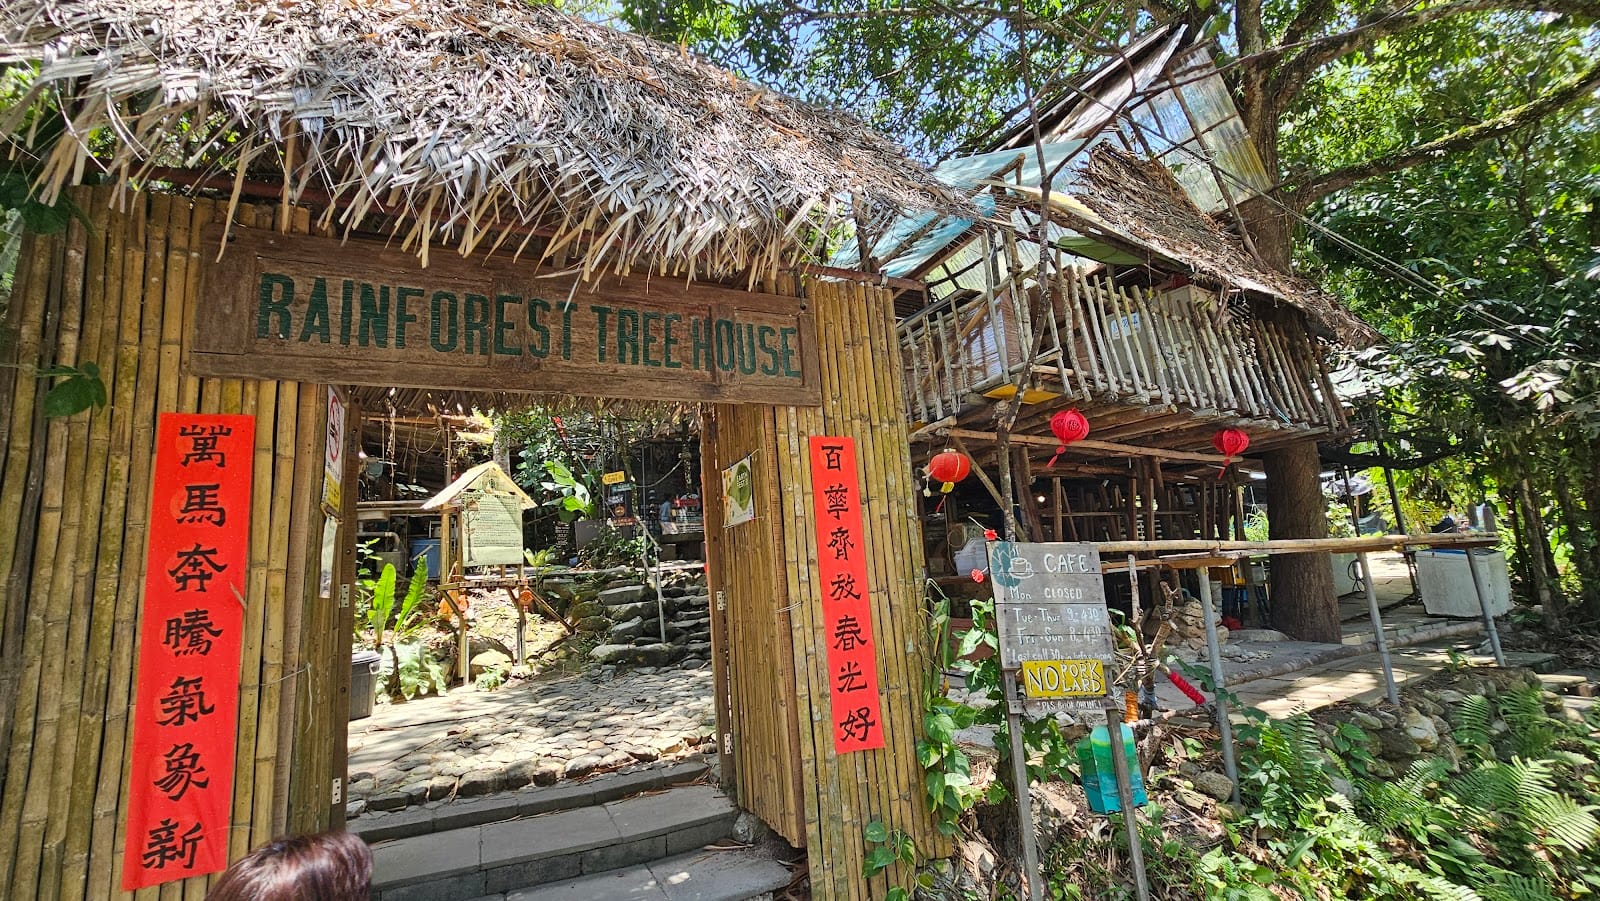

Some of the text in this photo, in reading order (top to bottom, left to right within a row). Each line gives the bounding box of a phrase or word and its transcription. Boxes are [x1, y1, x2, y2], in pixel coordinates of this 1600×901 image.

[257, 272, 801, 378] RAINFOREST TREE HOUSE
[1043, 553, 1089, 573] CAFE
[1009, 585, 1083, 600] Mon CLOSED
[142, 424, 233, 870] 萬馬奔騰氣象新
[1026, 662, 1102, 693] NO PORK
[1061, 678, 1102, 693] LARD
